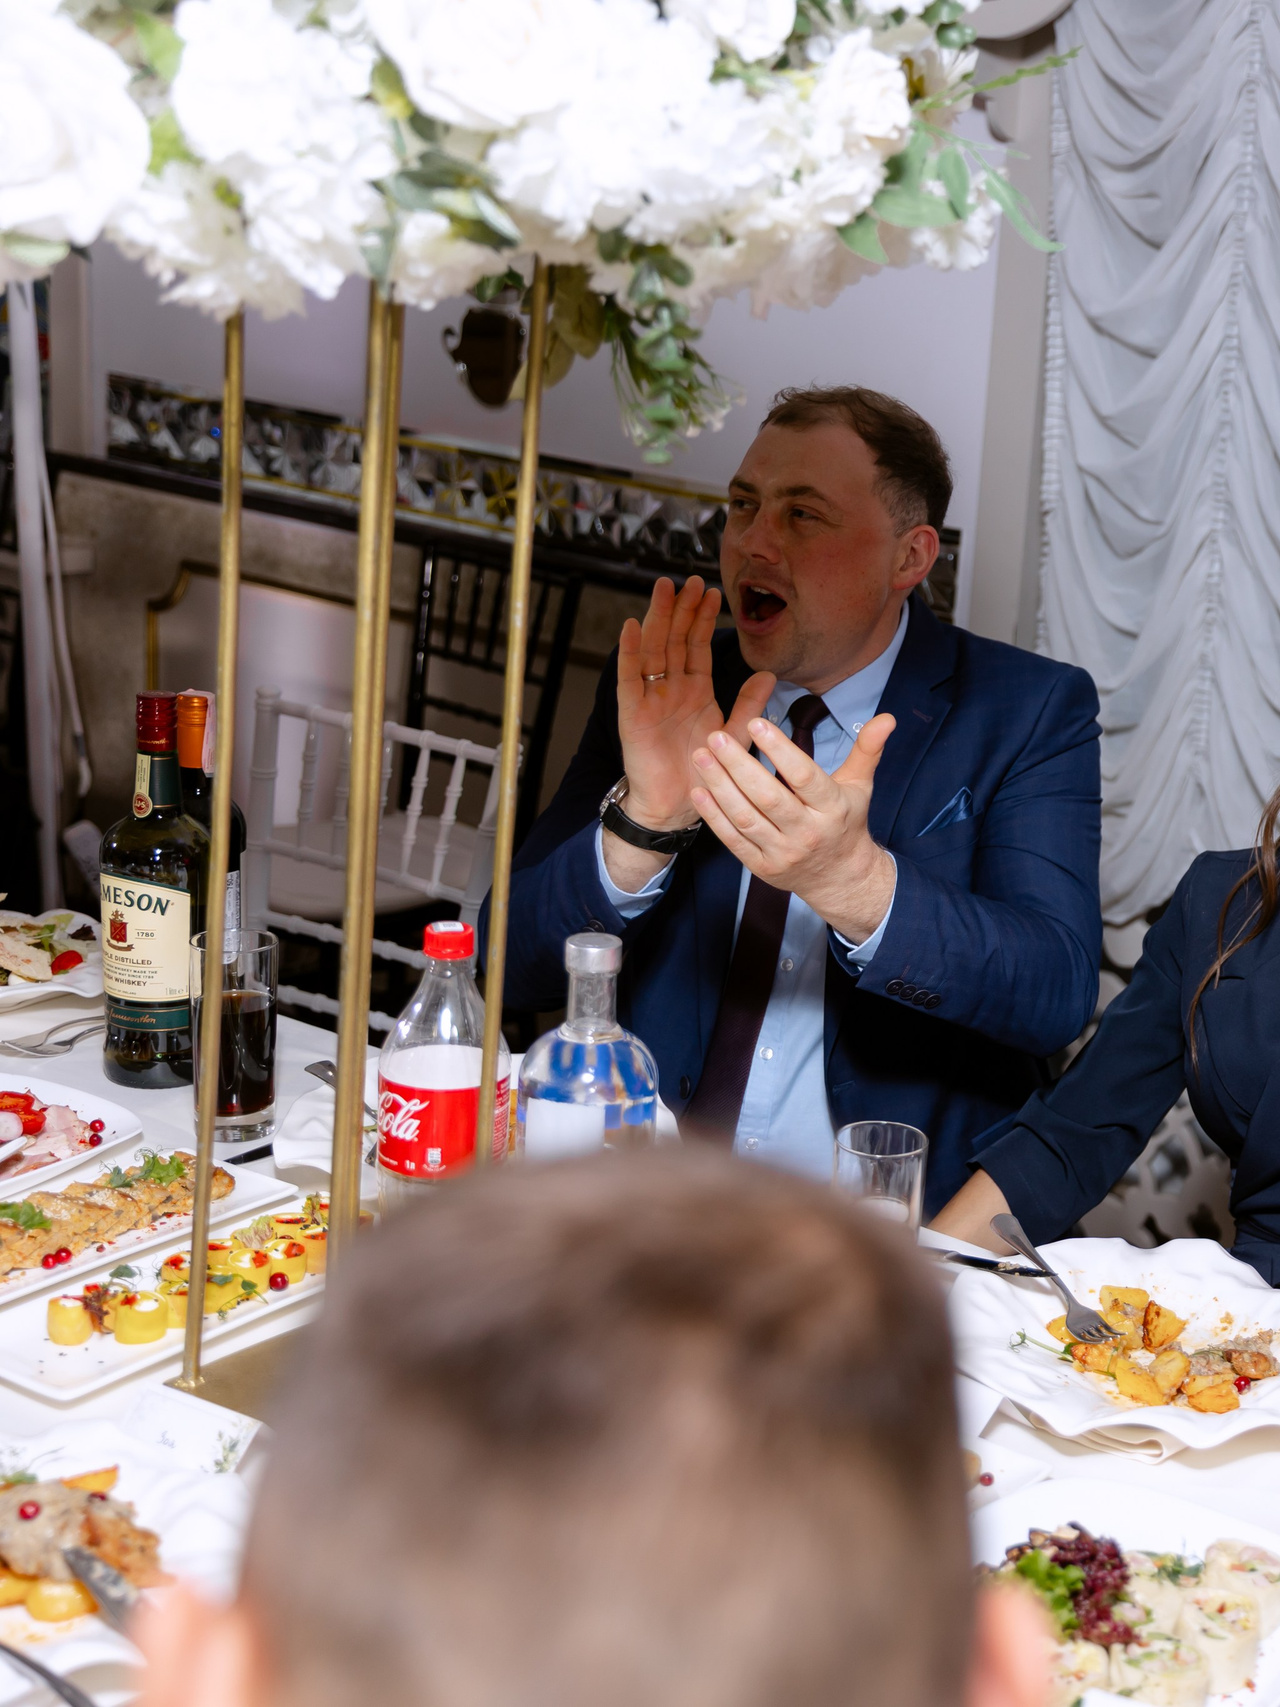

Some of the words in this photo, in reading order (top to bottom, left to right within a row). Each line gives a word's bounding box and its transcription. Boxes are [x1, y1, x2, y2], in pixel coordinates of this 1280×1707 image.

[101, 884, 170, 916] MESON
[114, 955, 152, 966] DISTILLED
[114, 976, 147, 987] WHISKEY
